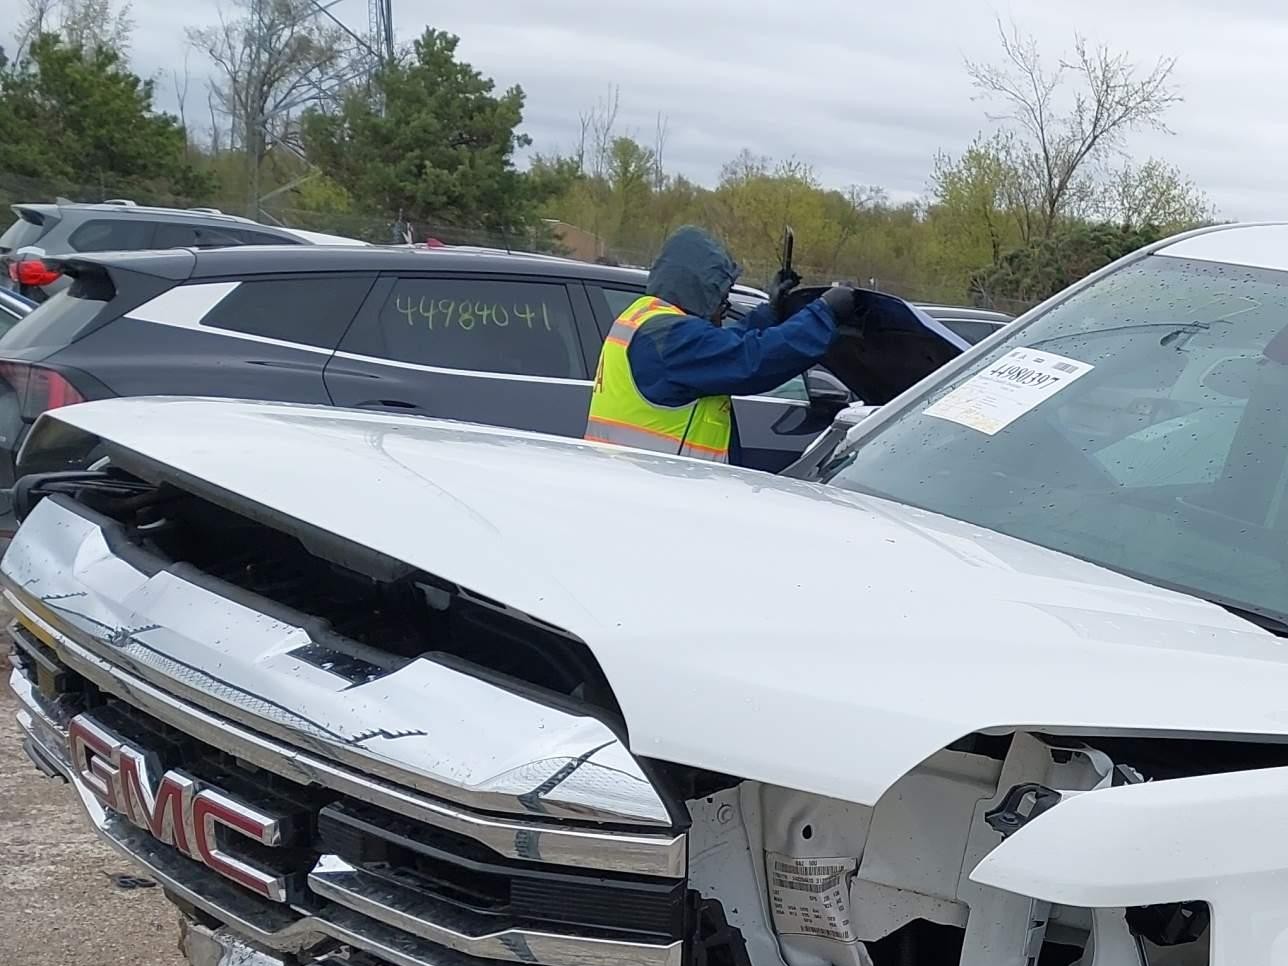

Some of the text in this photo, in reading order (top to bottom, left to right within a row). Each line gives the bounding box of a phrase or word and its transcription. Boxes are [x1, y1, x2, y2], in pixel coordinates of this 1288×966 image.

[396, 296, 552, 331] 44984041
[989, 363, 1061, 390] 44980397
[69, 711, 287, 903] GMC
